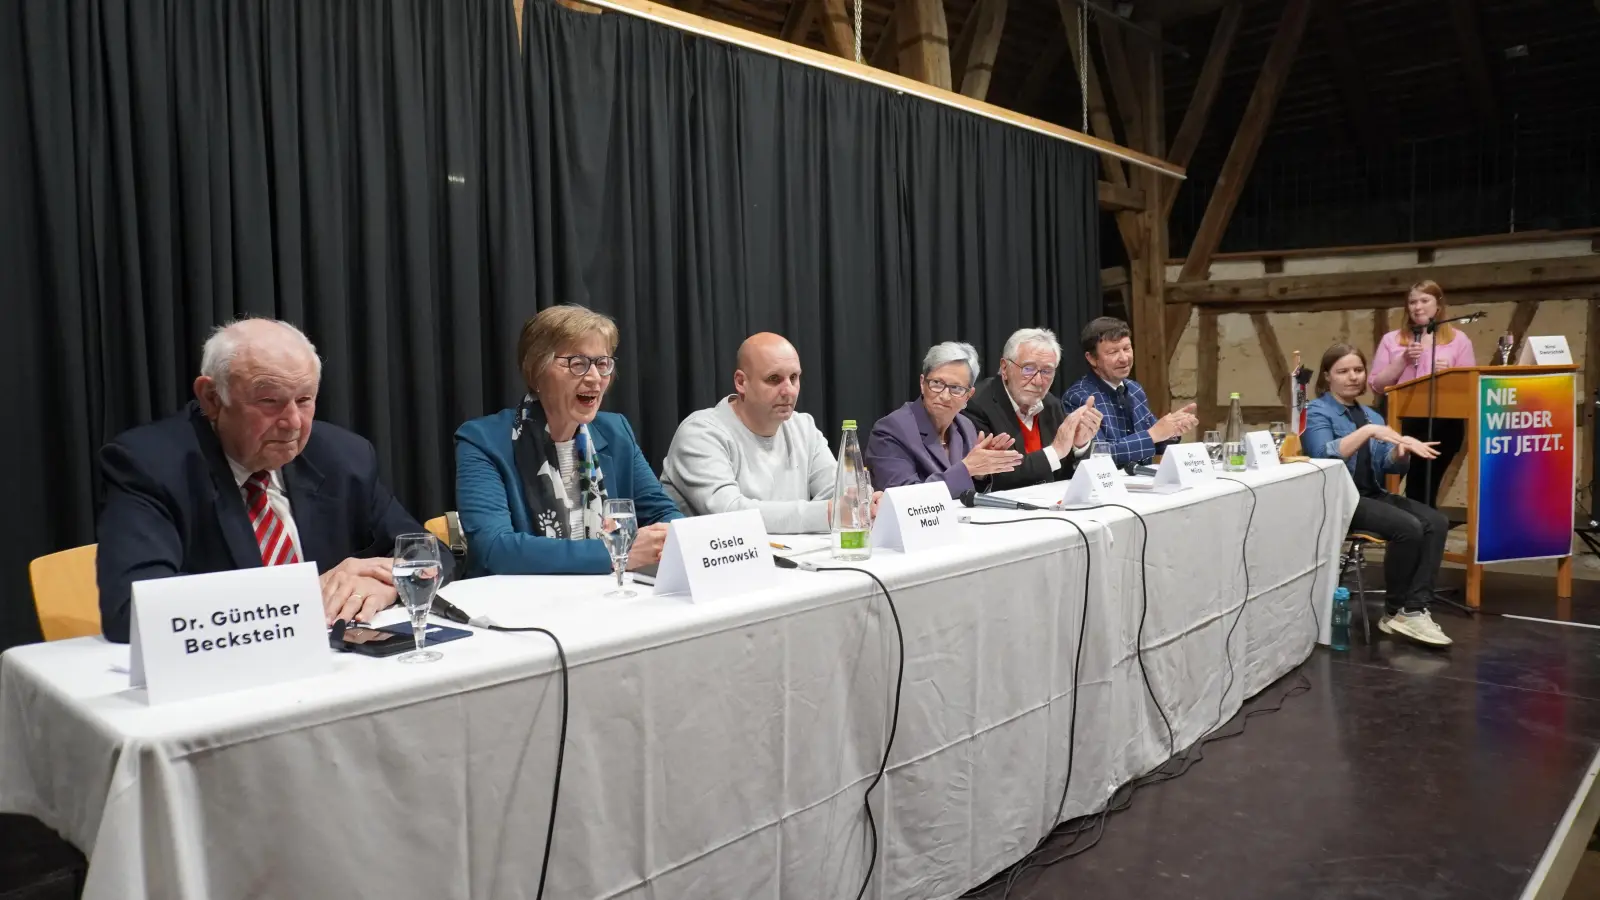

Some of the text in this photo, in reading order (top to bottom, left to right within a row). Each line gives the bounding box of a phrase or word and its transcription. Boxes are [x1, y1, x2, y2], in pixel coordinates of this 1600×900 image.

[1486, 387, 1517, 406] NIE
[1486, 410, 1553, 430] WIEDER
[1485, 433, 1565, 457] IST JETZT.
[907, 502, 946, 518] Christoph
[920, 516, 940, 528] Maul
[709, 535, 745, 551] Gisela
[702, 548, 759, 569] Bornowski
[172, 602, 300, 633] Dr. Günther
[184, 624, 295, 655] Beckstein
